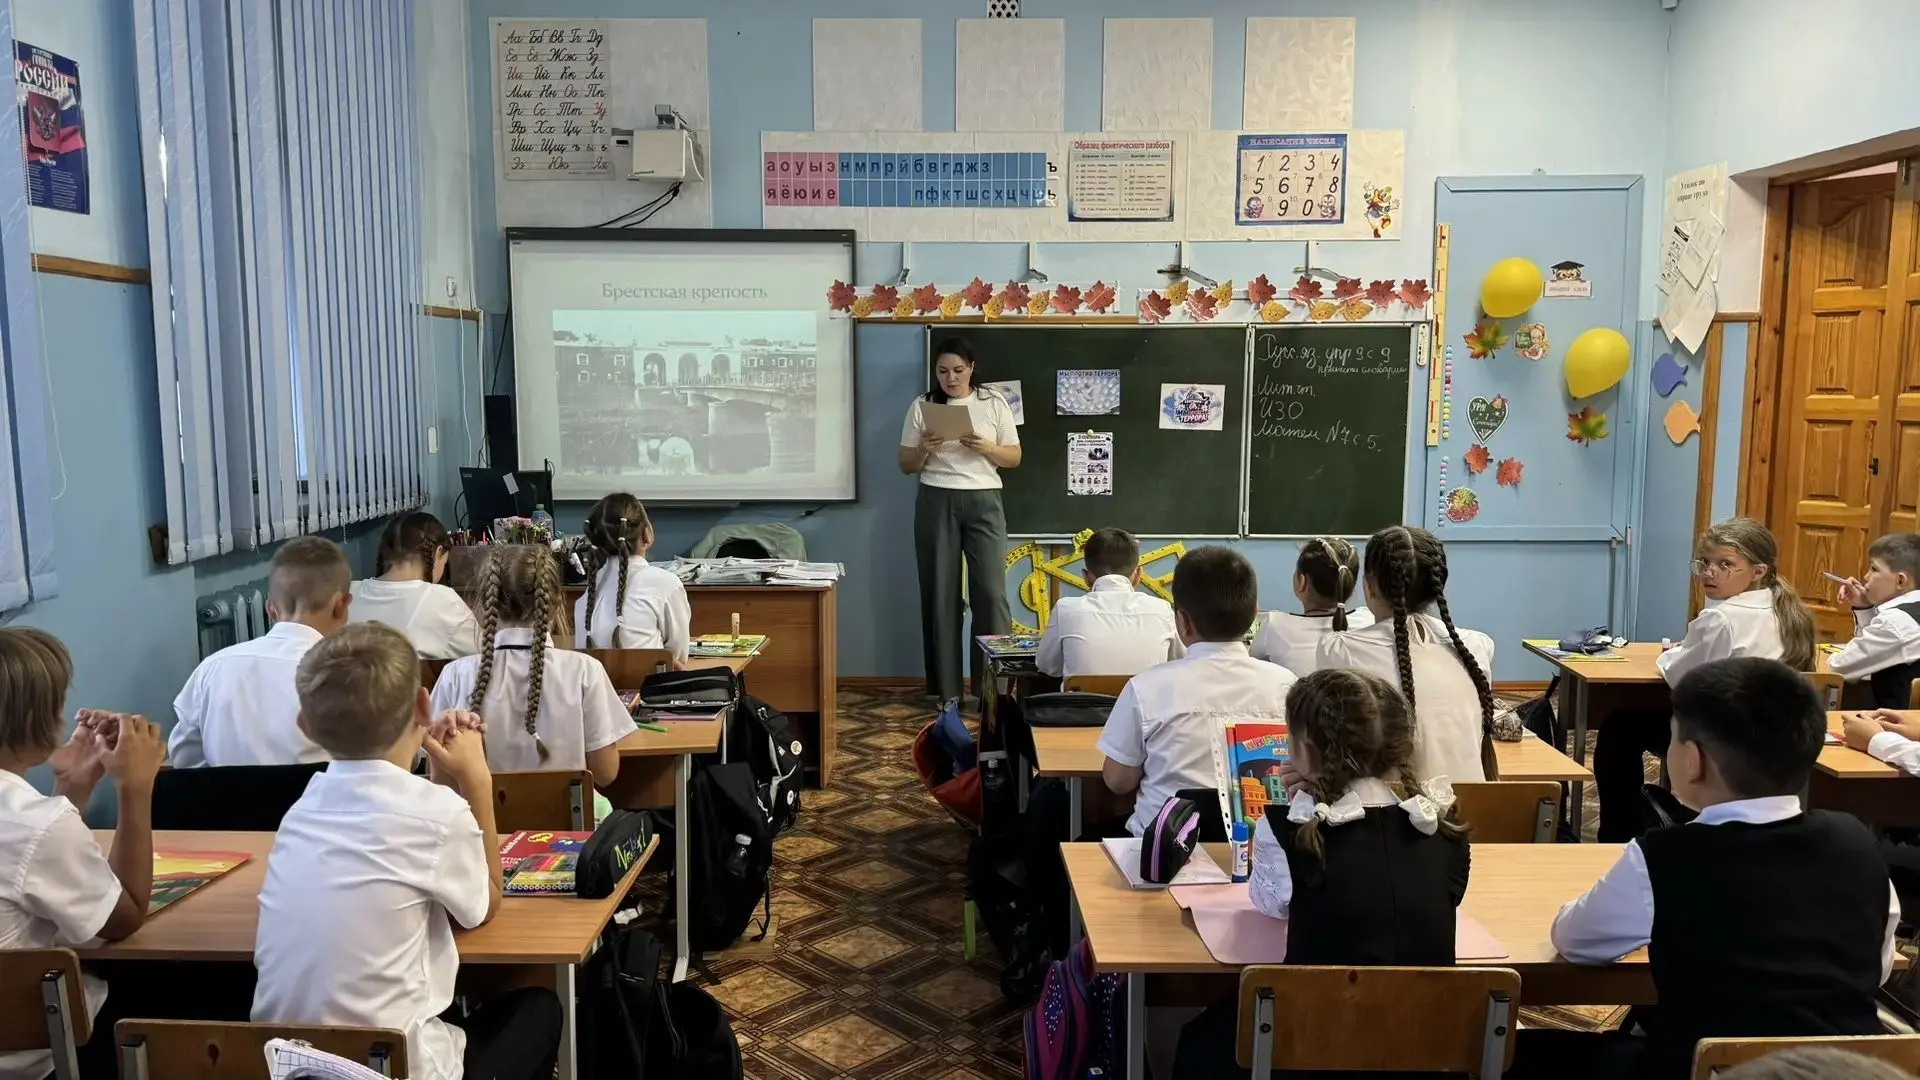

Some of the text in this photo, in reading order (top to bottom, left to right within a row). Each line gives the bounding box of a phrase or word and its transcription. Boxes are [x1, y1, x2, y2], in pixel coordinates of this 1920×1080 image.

[1075, 141, 1169, 150] Образец фонетического разбора
[1257, 155, 1265, 172] 1
[1279, 155, 1290, 171] 2
[1304, 154, 1315, 171] 3
[1331, 154, 1340, 171] 4
[1253, 177, 1264, 194] 5
[1278, 177, 1290, 193] 6
[1305, 176, 1315, 193] 7
[1329, 176, 1339, 193] 8
[1278, 200, 1289, 216] 9
[1303, 200, 1313, 216] 0
[602, 283, 768, 301] Брестская крепость
[1260, 397, 1303, 420] ИЗО
